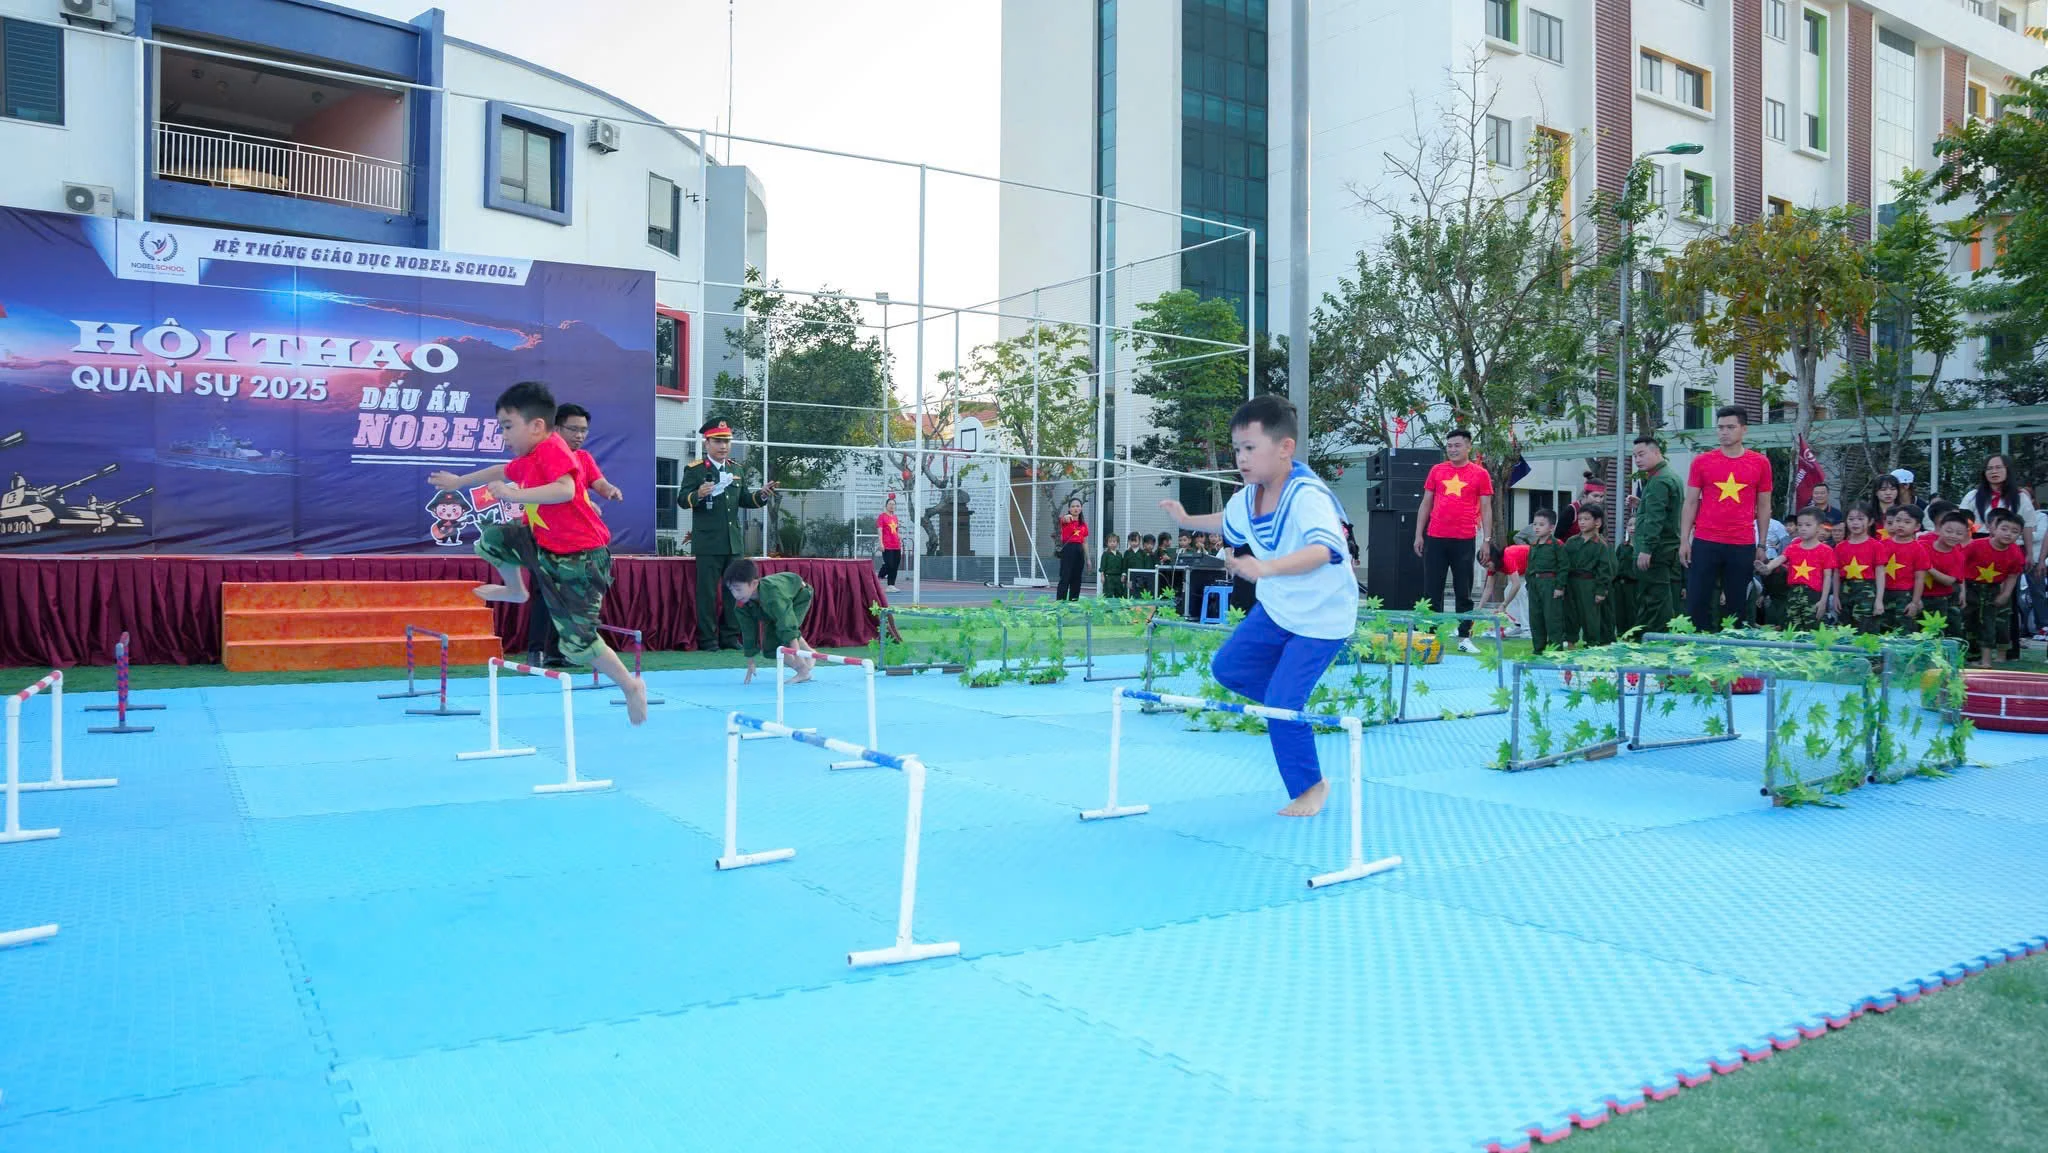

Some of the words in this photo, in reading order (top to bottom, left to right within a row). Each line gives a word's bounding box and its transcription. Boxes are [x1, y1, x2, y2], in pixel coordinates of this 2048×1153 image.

[213, 237, 241, 258] HỆ
[245, 240, 307, 261] THỐNG
[356, 252, 391, 270] DỤC
[394, 255, 452, 274] NOBEL
[454, 261, 518, 279] SCHOOL
[69, 317, 239, 367] HỘI
[250, 332, 460, 374] THAO
[71, 364, 184, 395] QUÂN
[194, 372, 243, 402] SỰ
[250, 375, 329, 402] 2025
[359, 379, 422, 412] DẤU
[425, 381, 471, 414] ẤN
[352, 412, 506, 453] NOBEL
